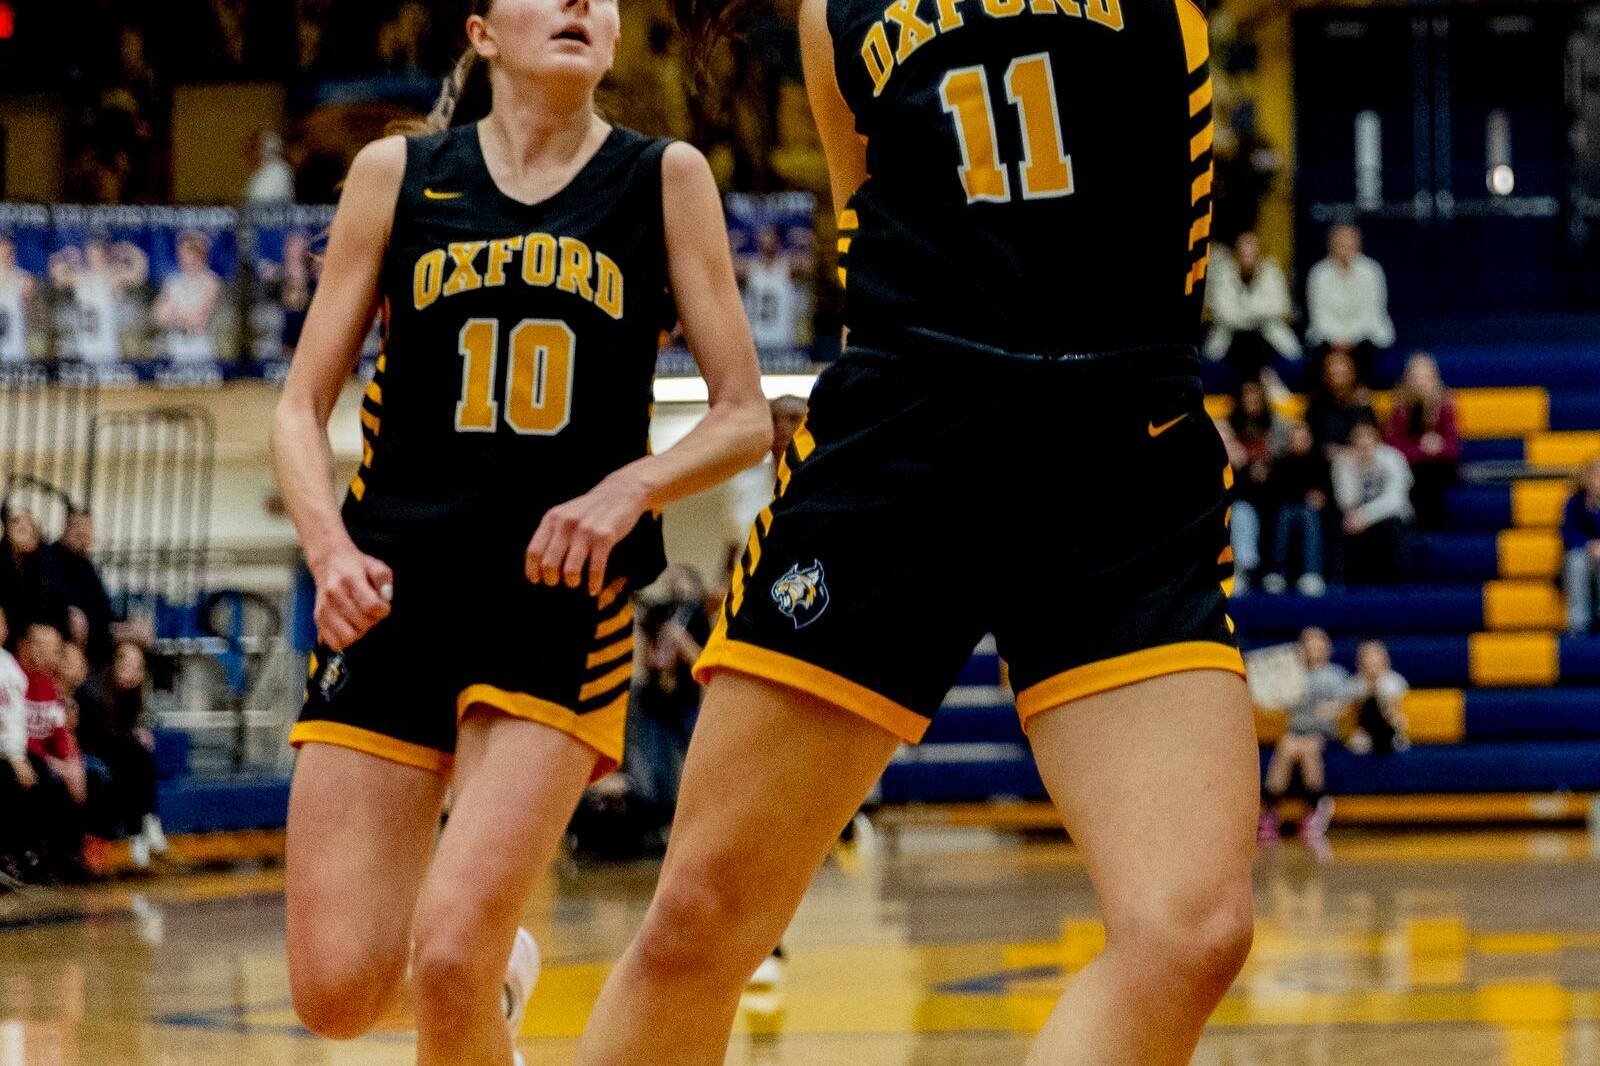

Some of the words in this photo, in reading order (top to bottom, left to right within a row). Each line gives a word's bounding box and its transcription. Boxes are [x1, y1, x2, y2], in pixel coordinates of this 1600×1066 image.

[939, 51, 1075, 205] 11
[413, 232, 625, 320] OXFORD
[454, 317, 577, 436] 10
